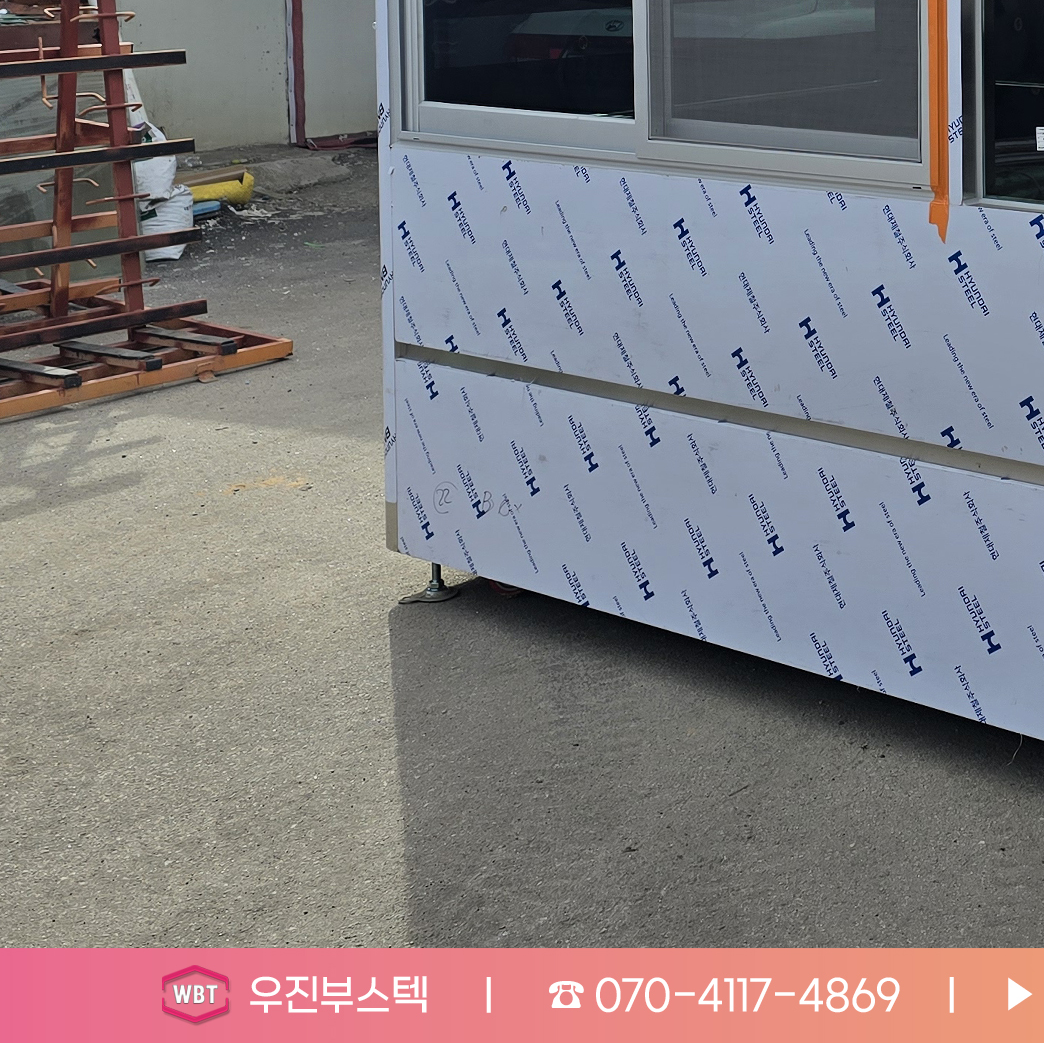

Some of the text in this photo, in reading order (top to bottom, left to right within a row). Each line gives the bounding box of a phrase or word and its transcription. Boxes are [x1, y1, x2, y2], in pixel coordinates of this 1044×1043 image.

[508, 180, 523, 210] STEEL
[512, 176, 533, 215] HYUNDAI
[454, 211, 468, 240] STEEL
[457, 207, 477, 245] HYUNDAI
[747, 207, 765, 239] STEEL
[752, 203, 776, 245] HYUNDAI
[403, 240, 417, 268] STEEL
[407, 236, 426, 274] HYUNDAI
[680, 239, 697, 271] STEEL
[685, 235, 708, 277] HYUNDAI
[618, 271, 634, 302] STEEL
[622, 267, 644, 308] HYUNDAI
[957, 275, 978, 310] STEEL
[963, 270, 991, 317] HYUNDAI
[559, 300, 574, 330] STEEL
[563, 296, 584, 337] HYUNDAI
[880, 308, 900, 343] STEEL
[886, 304, 913, 350] HYUNDAI
[504, 328, 519, 357] STEEL
[508, 324, 528, 363] HYUNDAI
[808, 339, 826, 373] STEEL
[813, 335, 838, 380] HYUNDAI
[740, 369, 757, 402] STEEL
[744, 365, 769, 409] HYUNDAI
[567, 414, 587, 455] HYUNDAI
[577, 421, 592, 452] STEEL
[509, 440, 529, 480] HYUNDAI
[519, 446, 534, 476] STEEL
[456, 463, 475, 503] HYUNDAI
[465, 470, 479, 500] STEEL
[816, 467, 841, 512] HYUNDAI
[829, 474, 847, 509] STEEL
[406, 486, 424, 524] HYUNDAI
[415, 492, 428, 521] STEEL
[747, 493, 771, 538] HYUNDAI
[759, 501, 776, 534] STEEL
[683, 517, 706, 561] HYUNDAI
[695, 525, 711, 557] STEEL
[620, 541, 642, 583] HYUNDAI
[631, 548, 647, 580] STEEL
[957, 585, 985, 634] HYUNDAI
[971, 594, 991, 630] STEEL
[881, 609, 907, 656] HYUNDAI
[894, 617, 913, 653] STEEL
